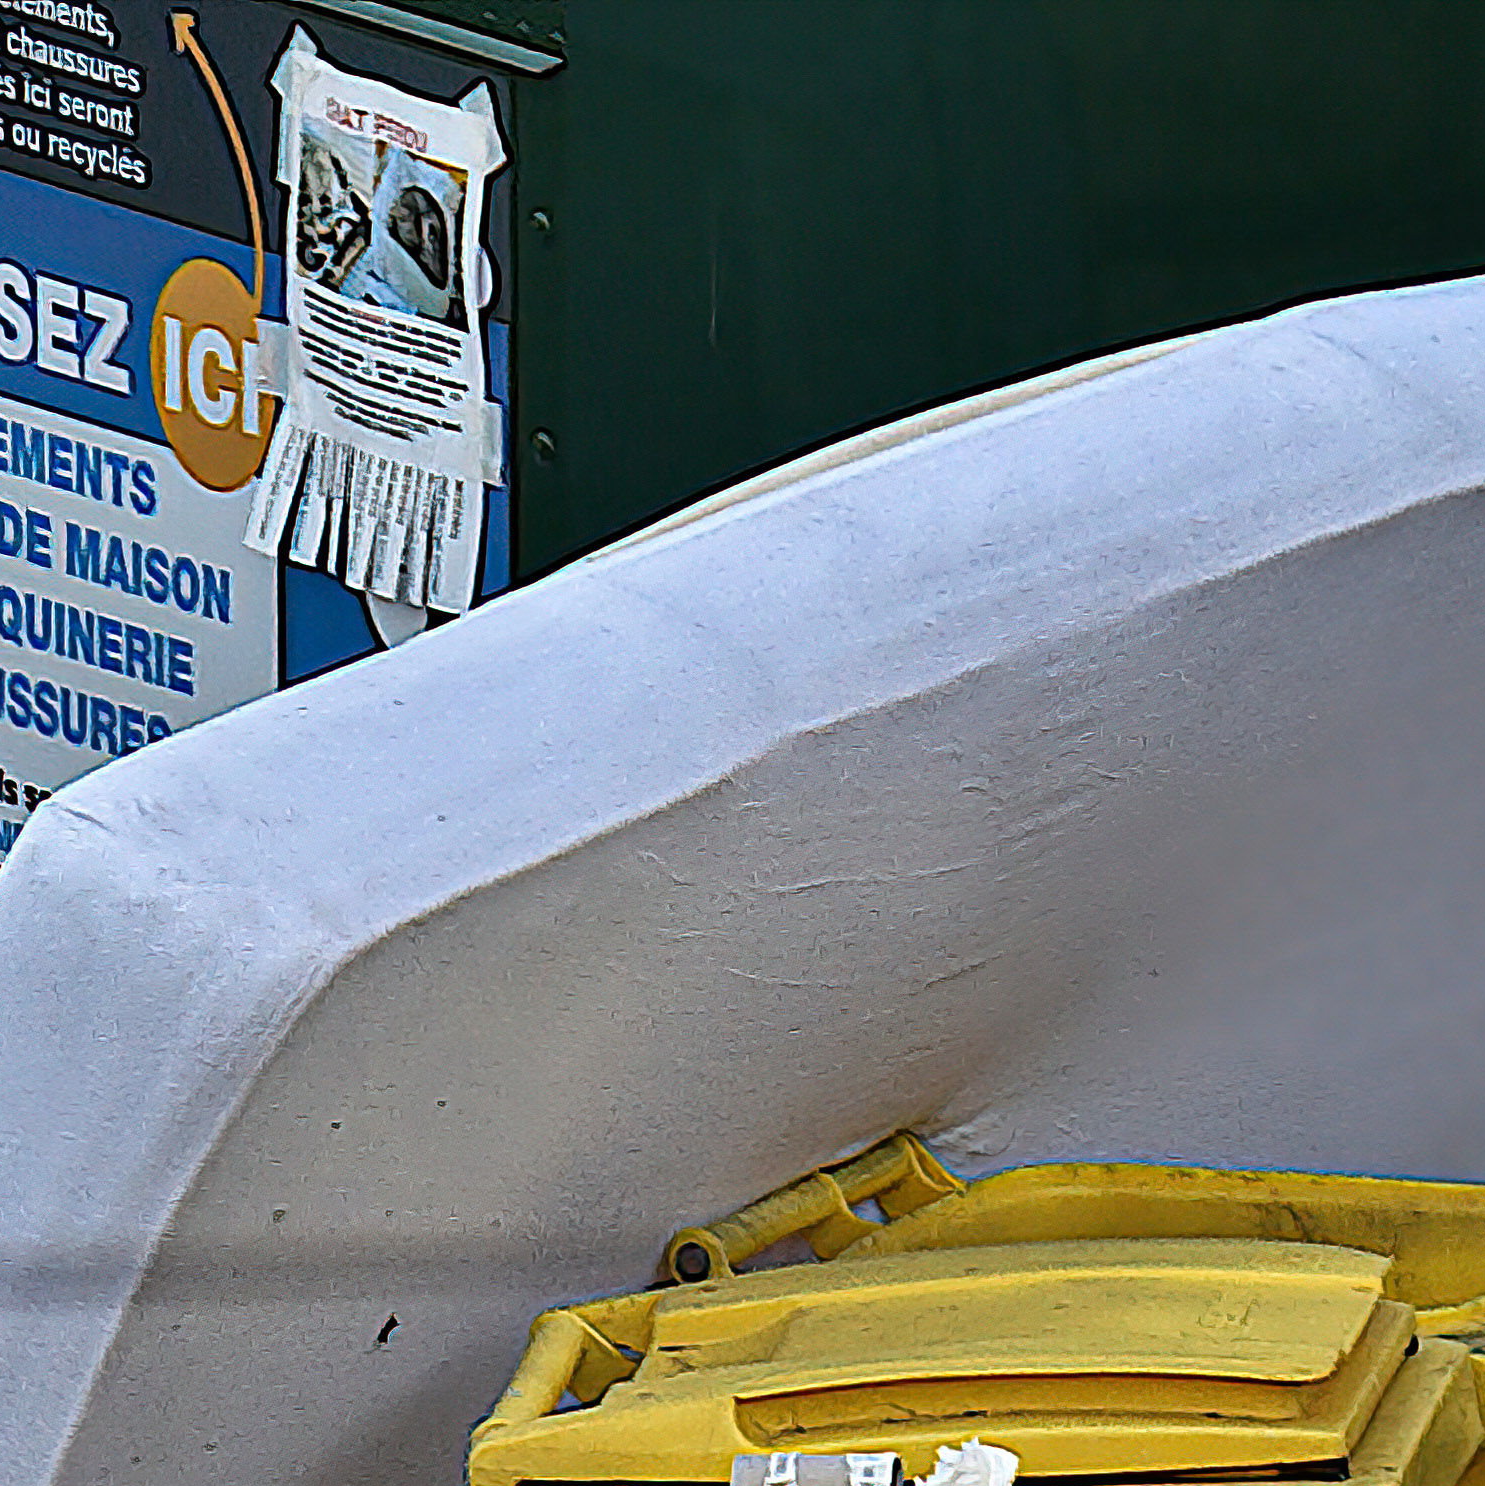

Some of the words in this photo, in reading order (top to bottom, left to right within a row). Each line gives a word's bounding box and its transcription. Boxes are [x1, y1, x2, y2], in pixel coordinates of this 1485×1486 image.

[6, 25, 141, 93] chaussures
[21, 70, 52, 110] ici
[58, 91, 135, 137] seront
[12, 122, 41, 152] ou
[47, 132, 147, 184] recyclés
[162, 314, 266, 436] ICI
[64, 520, 232, 625] MAISON
